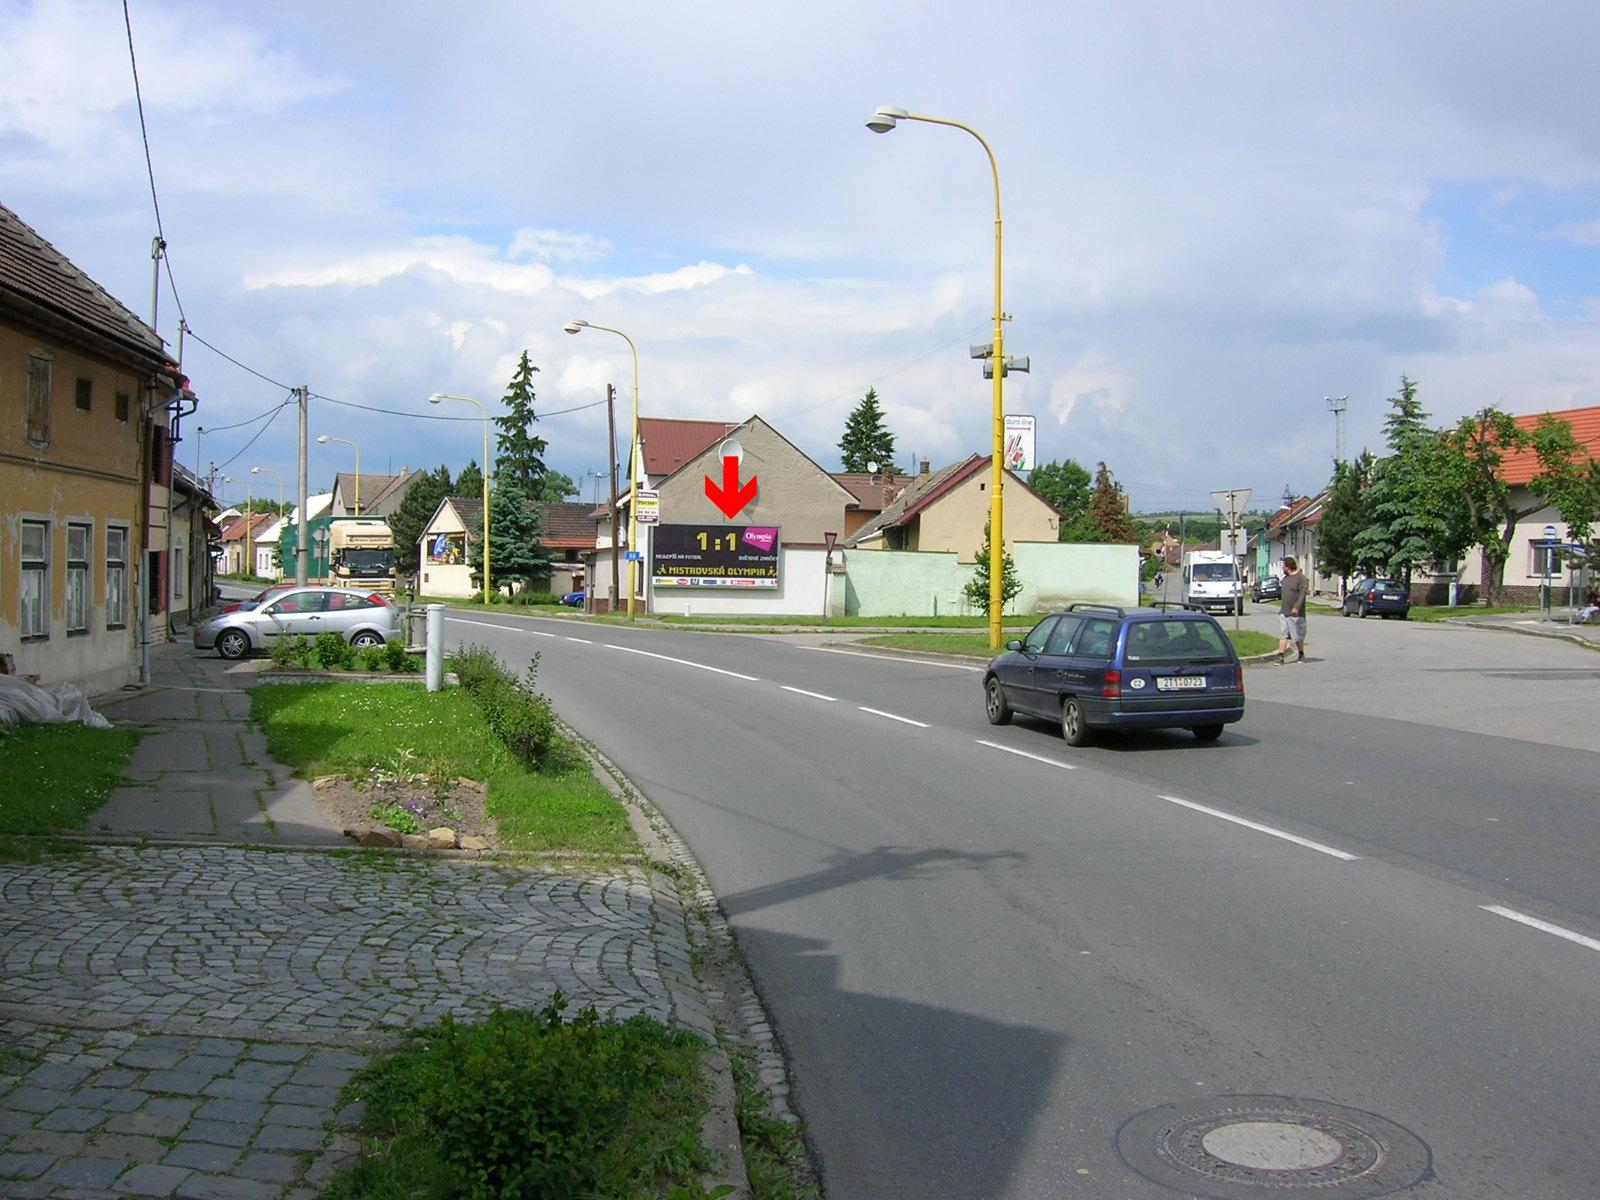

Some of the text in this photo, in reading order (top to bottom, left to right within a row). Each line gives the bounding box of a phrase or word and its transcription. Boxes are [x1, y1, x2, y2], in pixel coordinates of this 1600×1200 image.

[745, 532, 771, 540] Olympia
[669, 566, 766, 576] MISTROVSKÁ OLYMPIA
